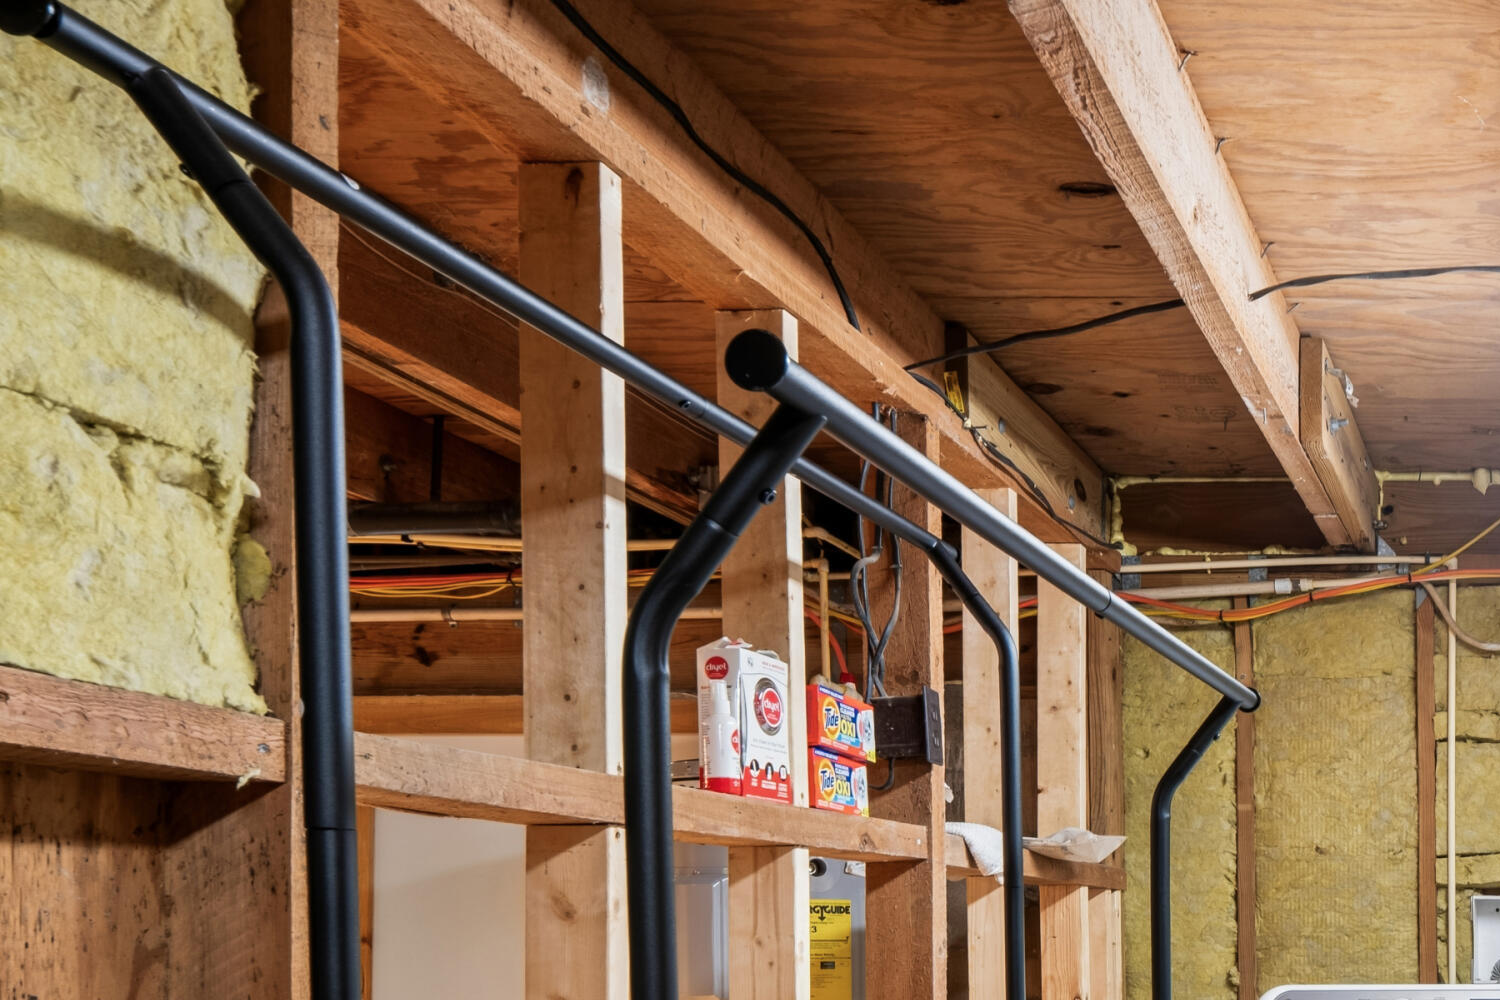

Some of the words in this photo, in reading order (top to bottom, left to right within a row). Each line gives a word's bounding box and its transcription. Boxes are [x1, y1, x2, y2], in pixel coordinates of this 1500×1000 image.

[824, 708, 839, 729] Tide
[841, 719, 856, 738] OXI
[820, 770, 835, 792] Tide
[836, 780, 851, 797] OXI
